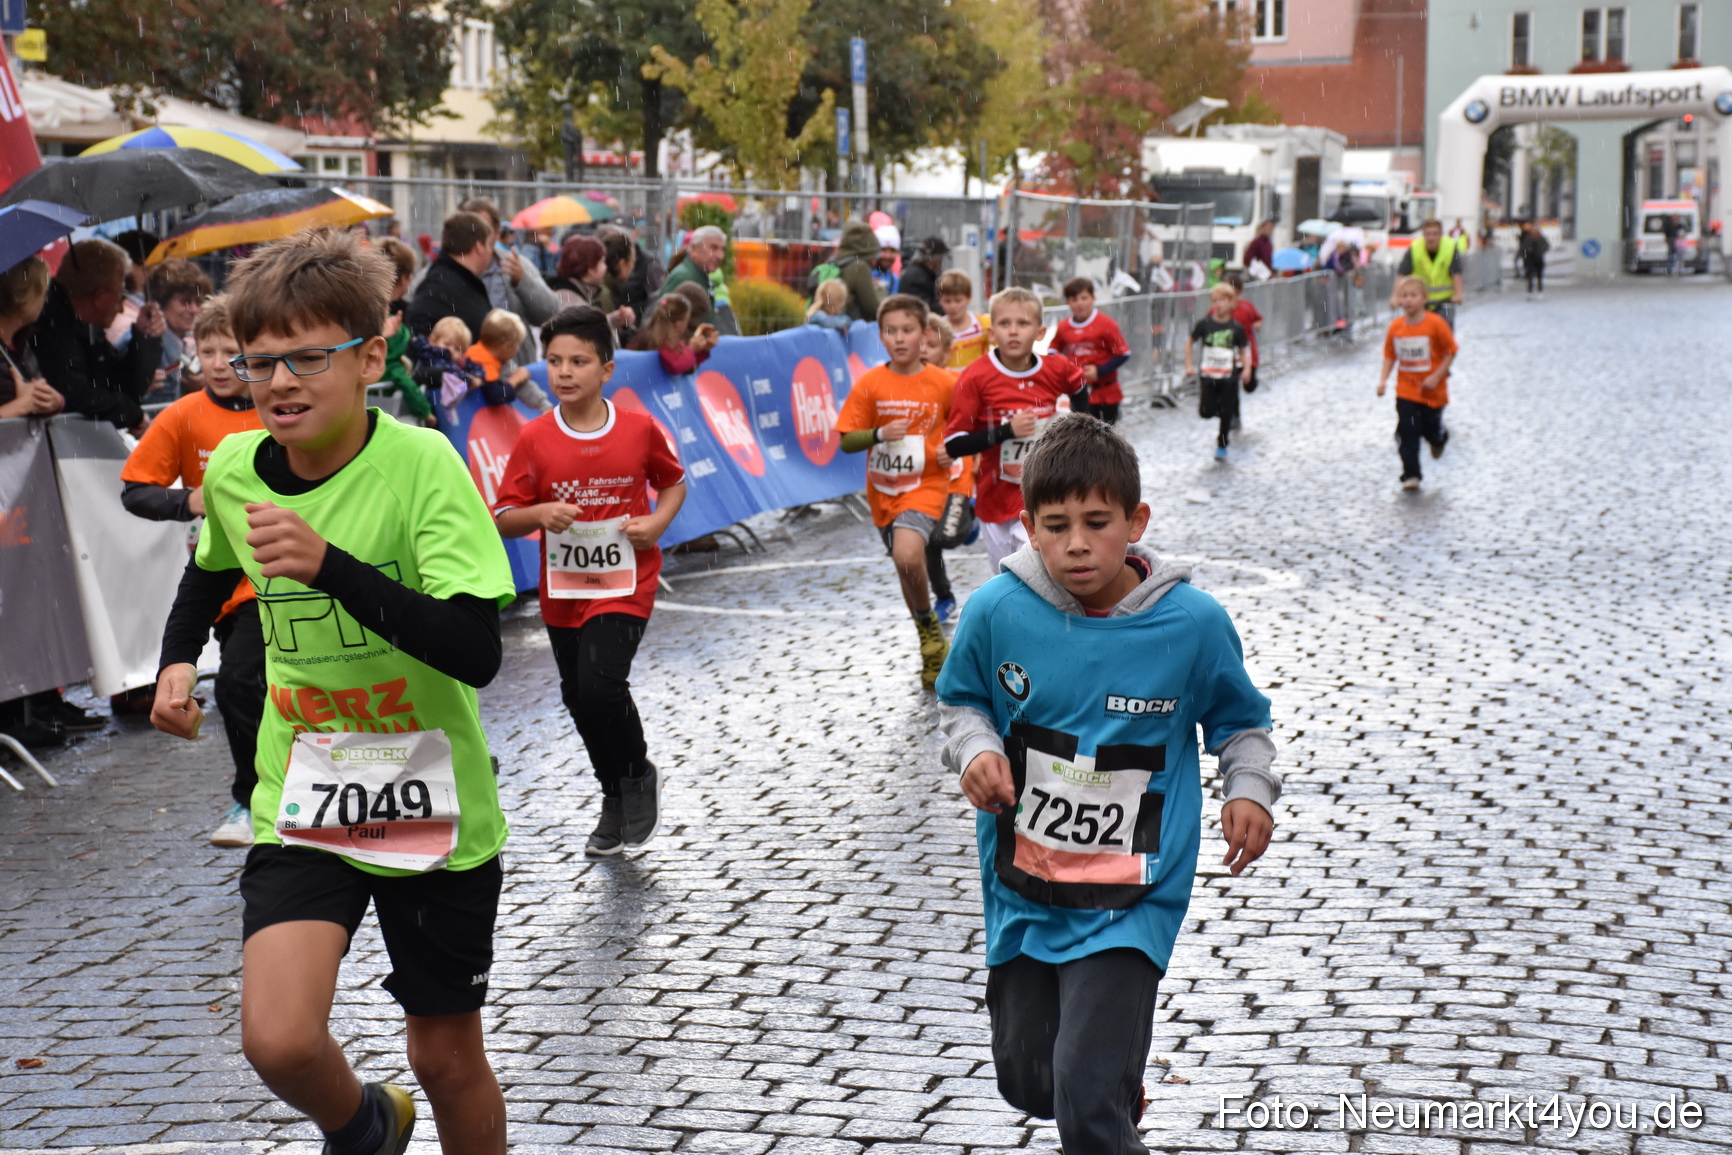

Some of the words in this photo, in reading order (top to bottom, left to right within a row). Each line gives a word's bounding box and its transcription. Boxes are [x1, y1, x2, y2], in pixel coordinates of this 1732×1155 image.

[1499, 87, 1569, 107] BMW
[1577, 81, 1704, 108] Laufsport
[875, 450, 914, 473] 7044
[588, 475, 634, 486] Fahrschule
[574, 489, 599, 498] KARG
[559, 543, 622, 569] 7046
[584, 575, 600, 585] Jan
[282, 647, 388, 666] Automatisierungstechnik
[1000, 663, 1028, 680] BMW
[270, 676, 414, 725] MERZ
[1105, 694, 1180, 714] BOCK
[348, 747, 408, 761] BOCK
[1064, 766, 1112, 784] BOCK
[311, 779, 433, 829] 7049
[284, 820, 298, 830] B6
[1027, 786, 1124, 846] 7252
[347, 825, 386, 840] Paul
